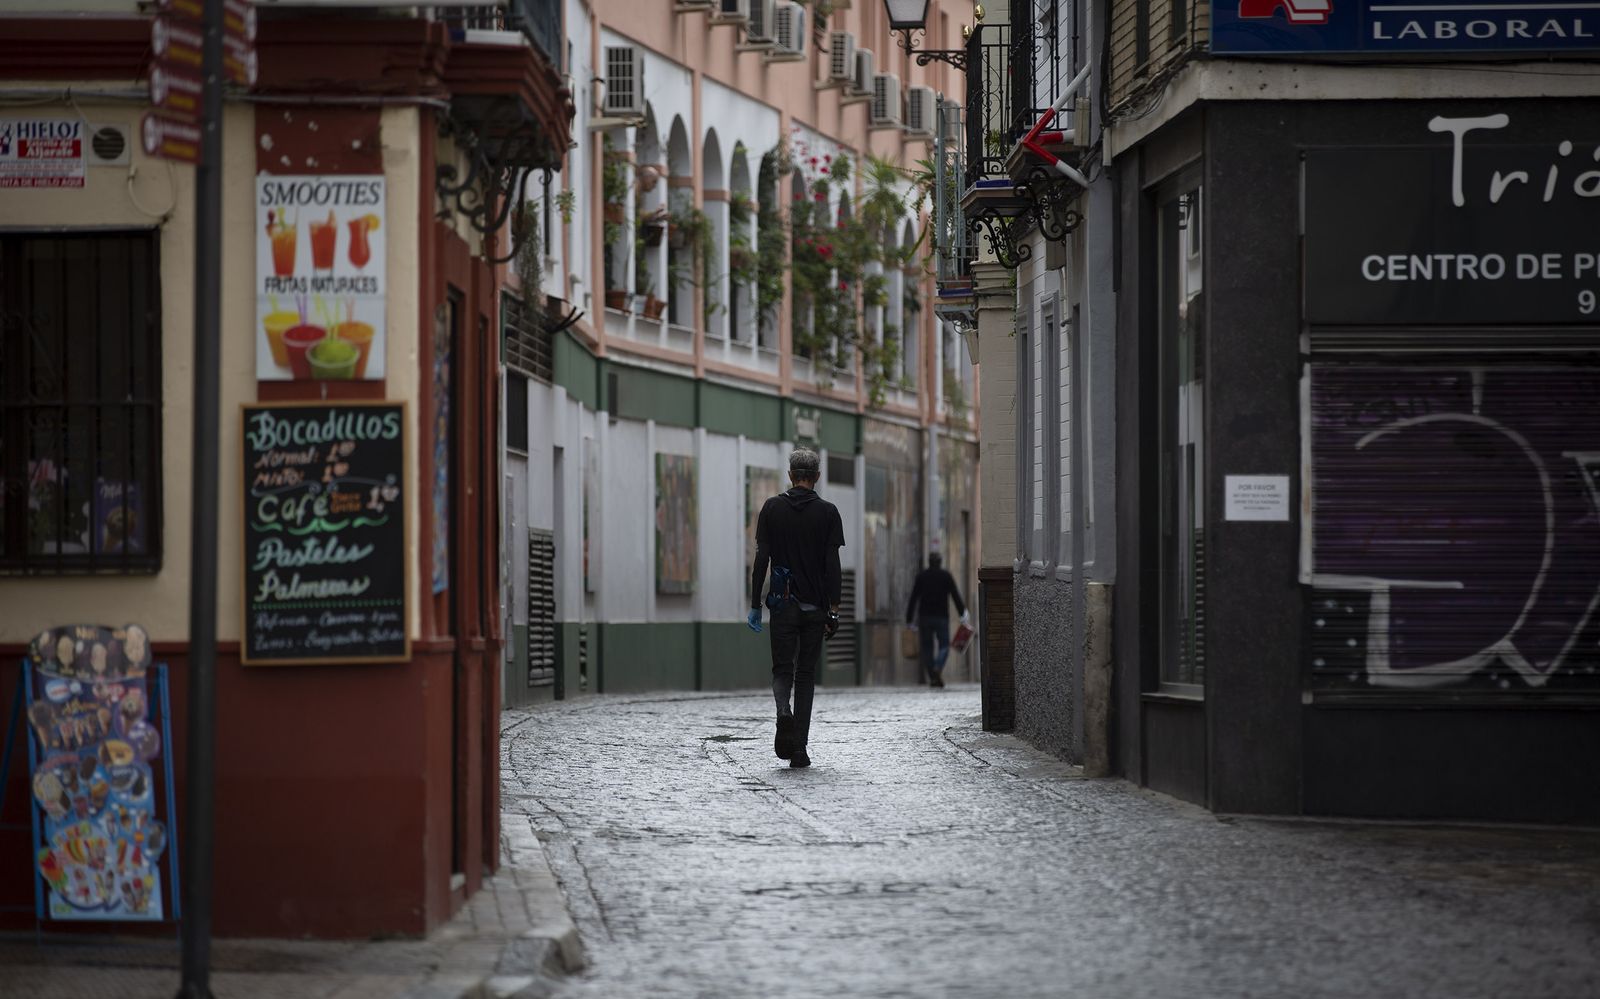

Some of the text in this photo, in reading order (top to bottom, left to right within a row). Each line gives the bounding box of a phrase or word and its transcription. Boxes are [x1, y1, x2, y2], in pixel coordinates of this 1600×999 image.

[1372, 19, 1594, 40] LABORAL
[17, 121, 80, 139] HIELOS
[260, 180, 382, 207] SMOOTIES
[1361, 252, 1600, 281] CENTRO DE P
[264, 276, 379, 296] FRUTAS NATURALES
[252, 534, 375, 572] Pasteles
